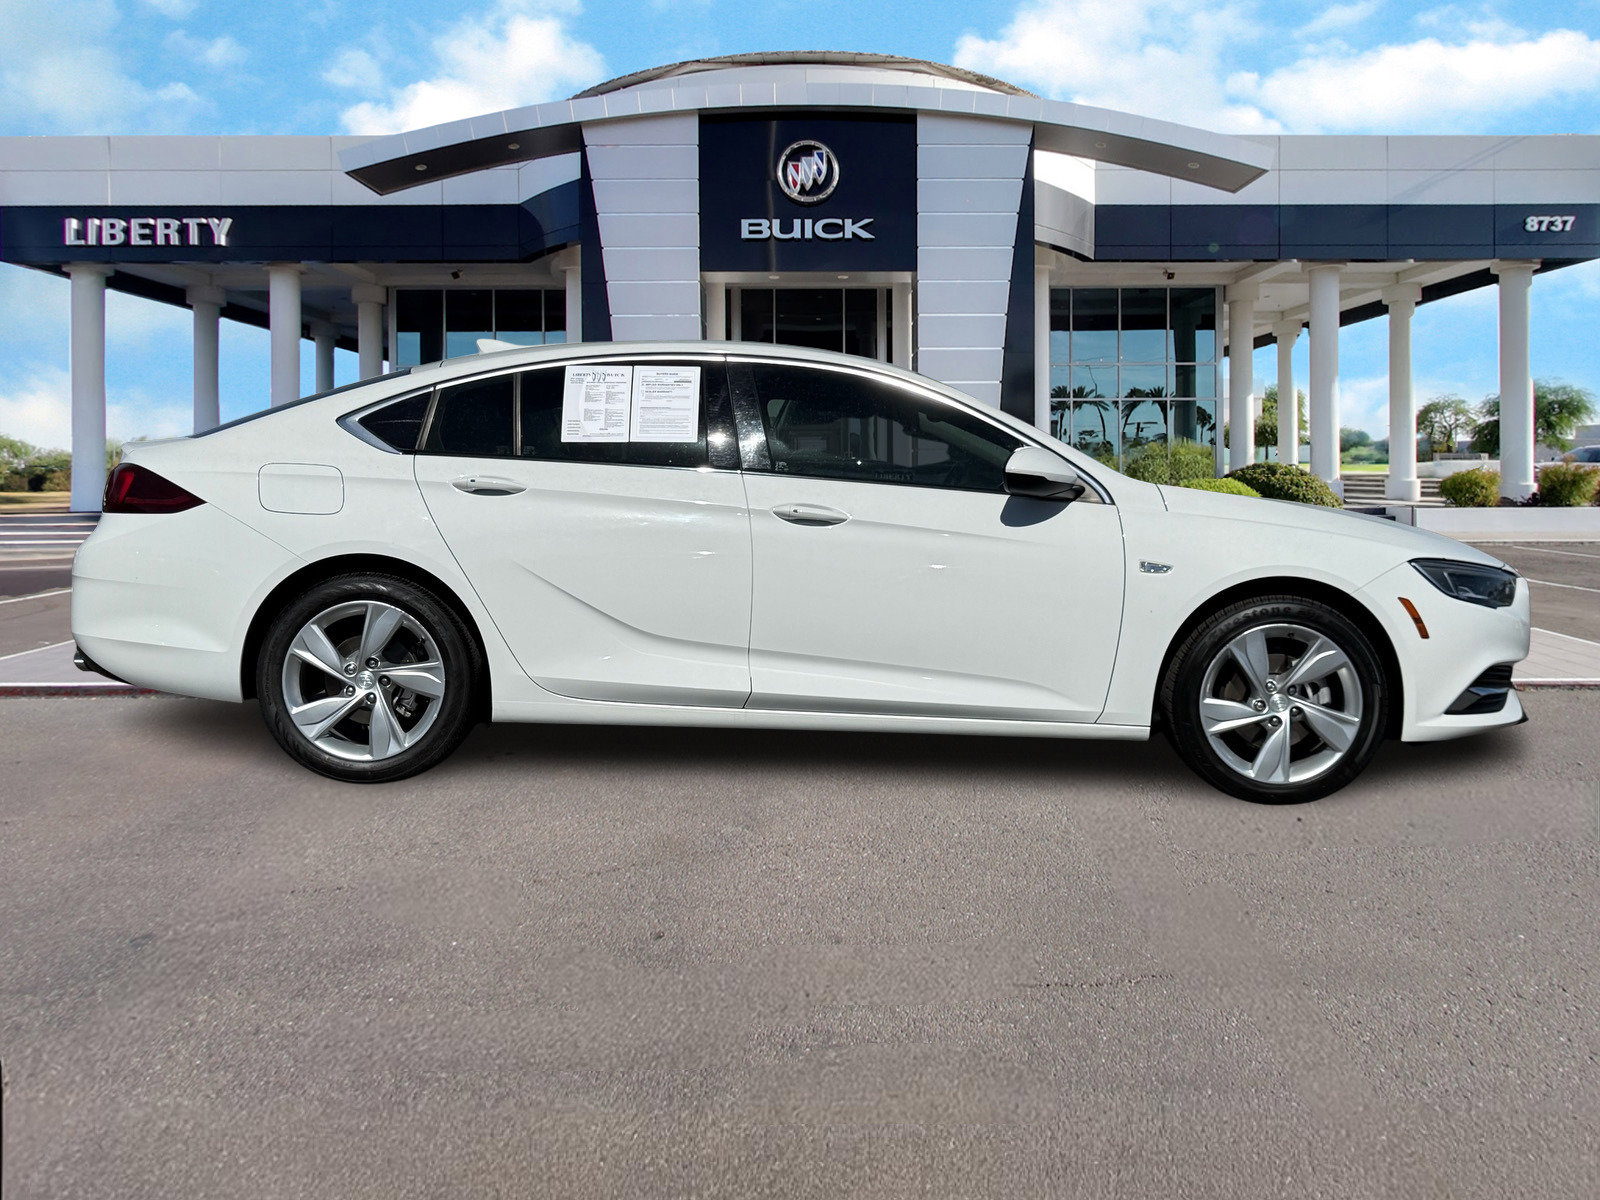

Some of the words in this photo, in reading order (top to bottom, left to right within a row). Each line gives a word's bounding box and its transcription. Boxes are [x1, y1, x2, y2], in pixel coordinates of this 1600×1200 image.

[64, 217, 233, 247] LIBERTY
[740, 217, 876, 240] BUICK
[1524, 214, 1576, 232] 8737
